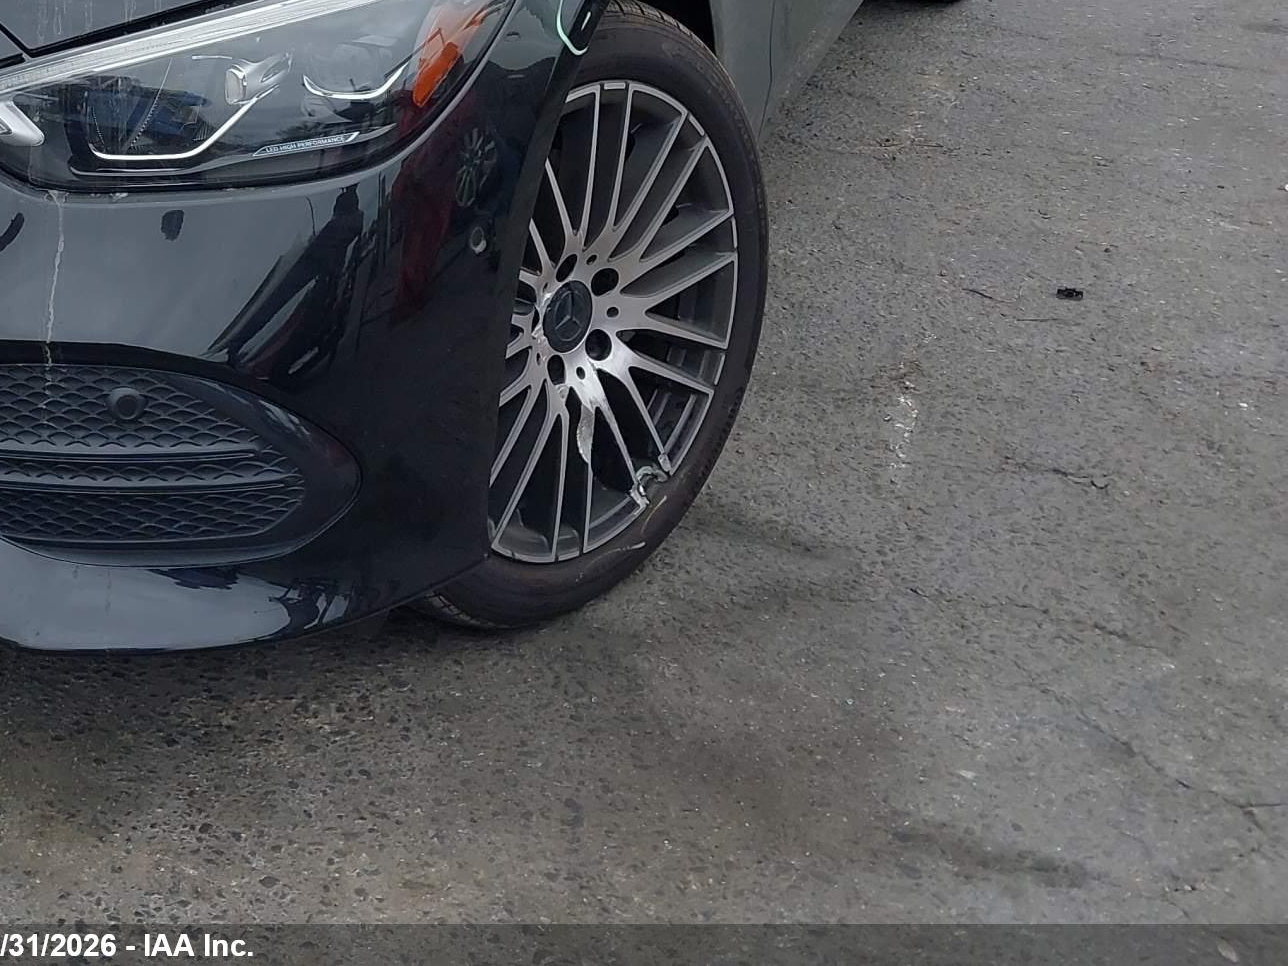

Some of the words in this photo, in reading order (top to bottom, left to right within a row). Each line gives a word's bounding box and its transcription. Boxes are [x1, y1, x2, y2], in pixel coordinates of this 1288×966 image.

[265, 145, 279, 153] LED
[279, 143, 297, 152] HIGH
[297, 136, 345, 148] PERFORMANCE
